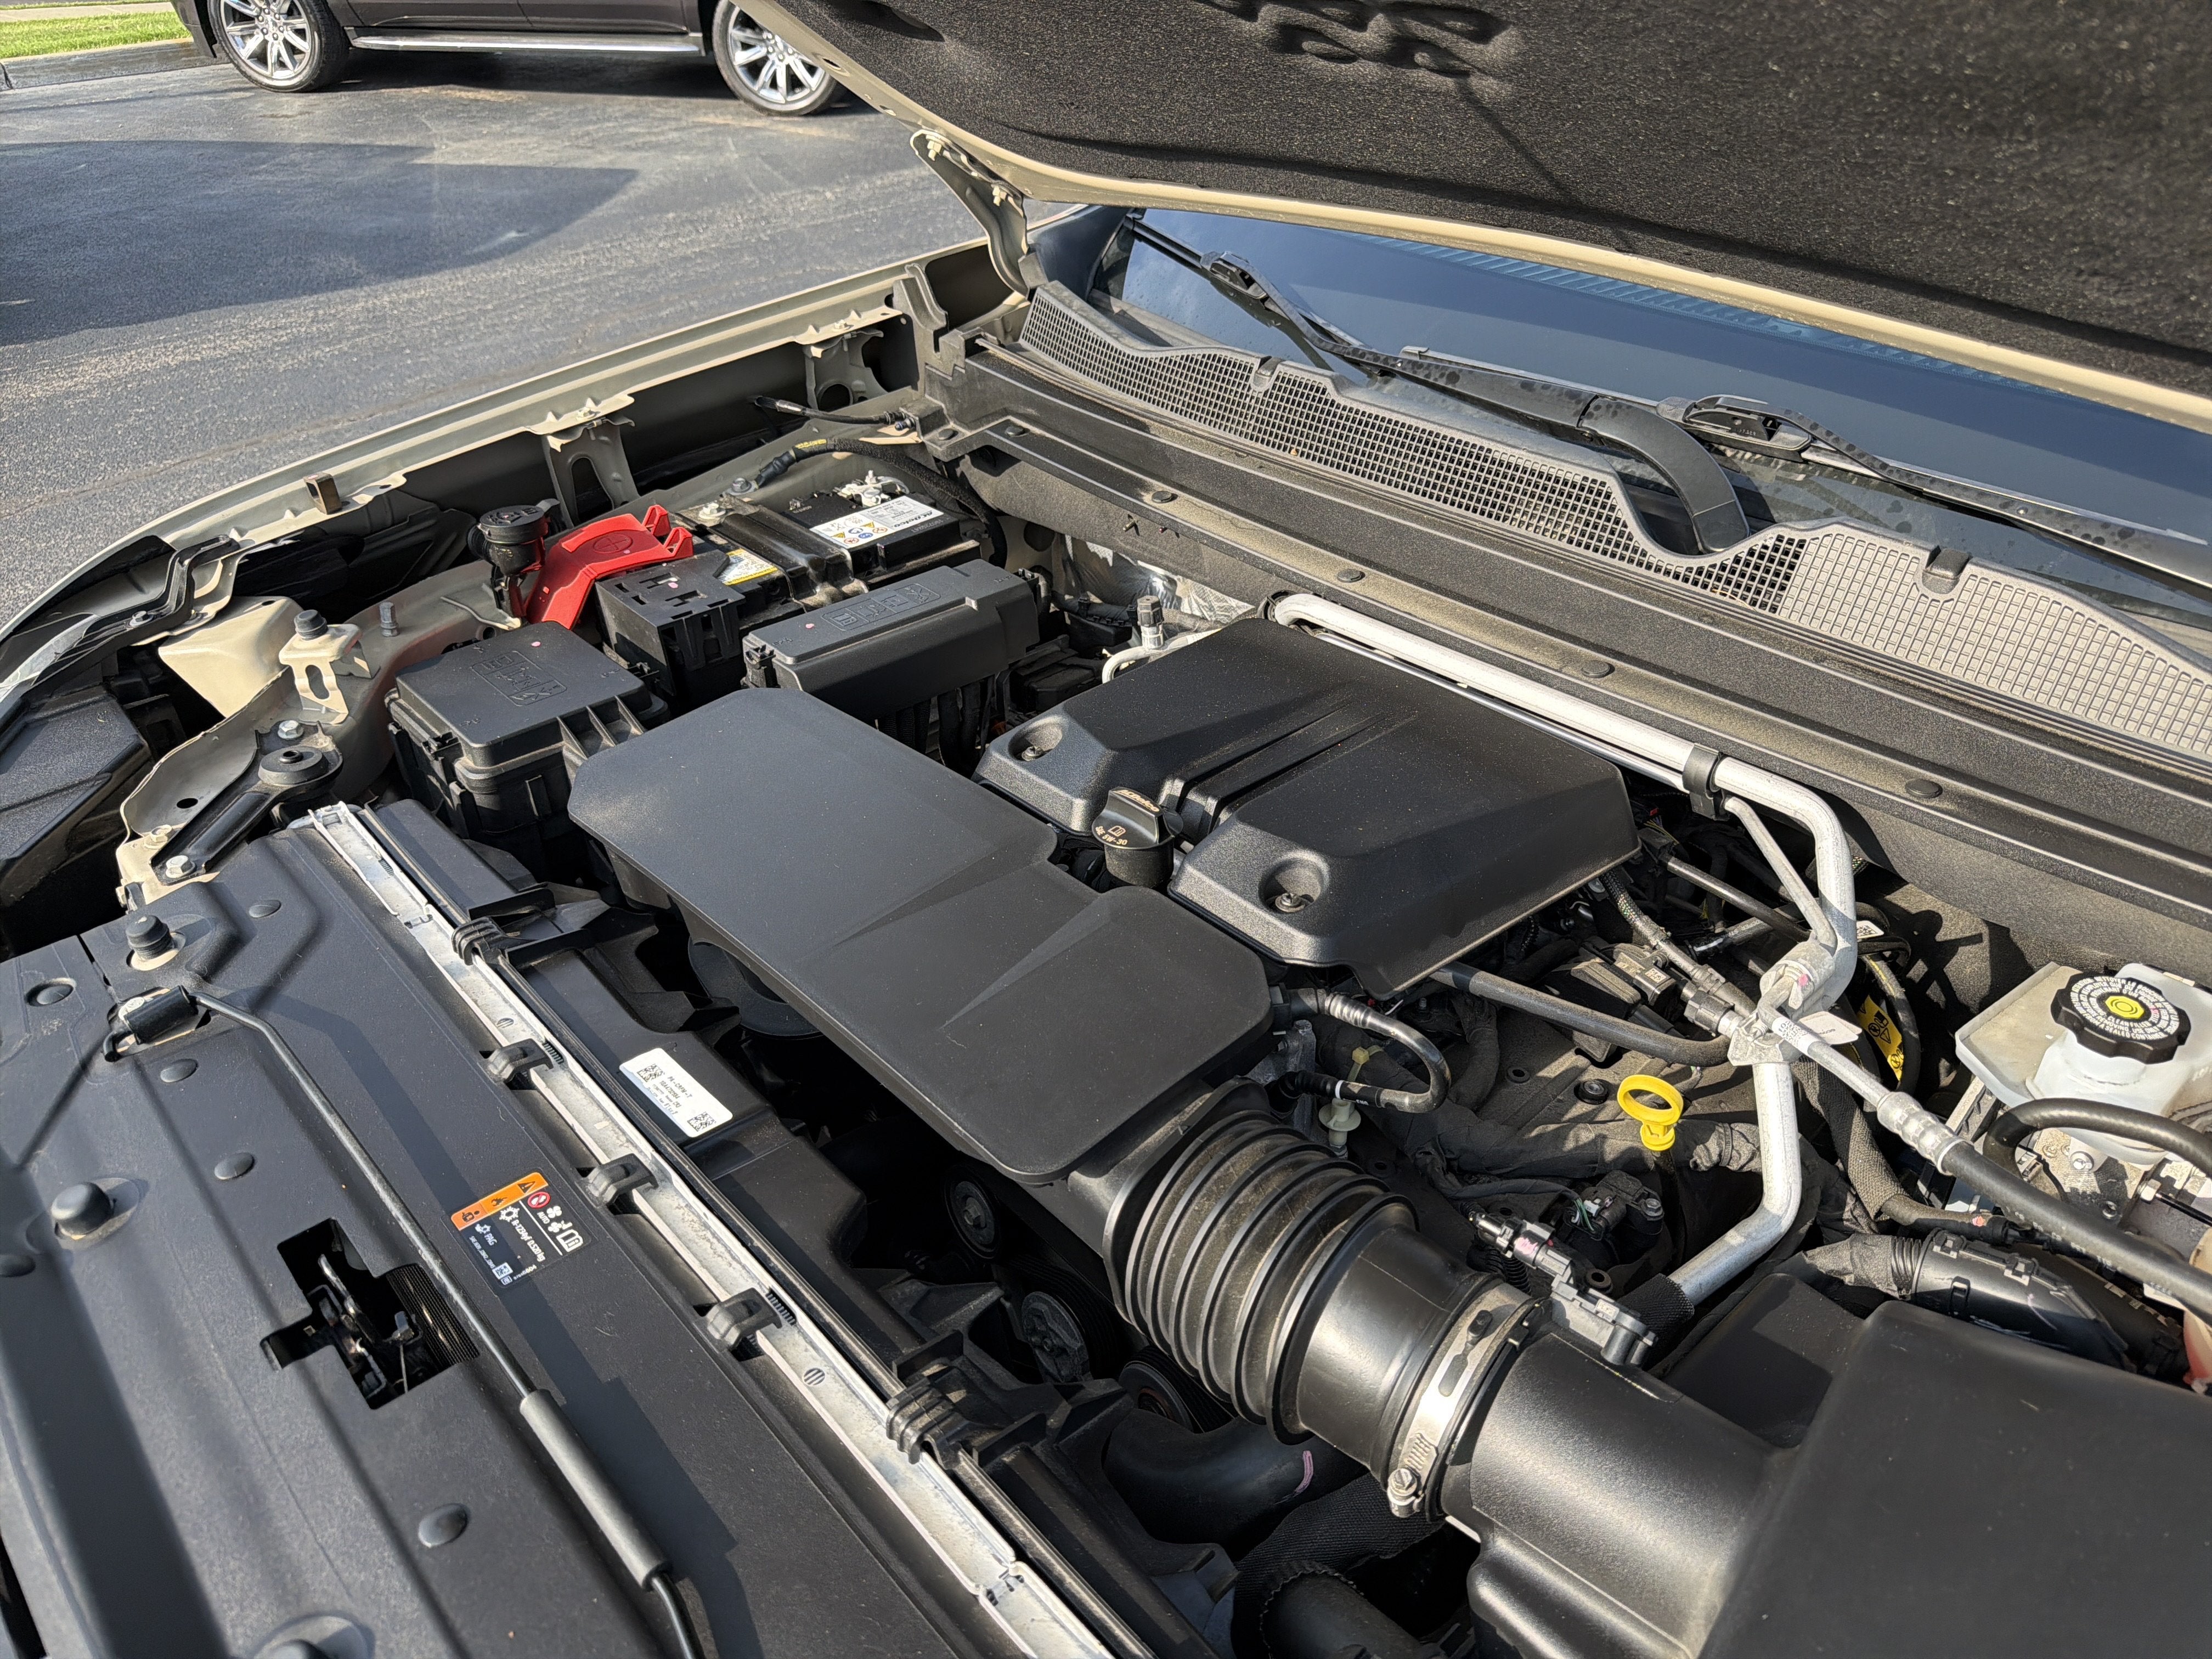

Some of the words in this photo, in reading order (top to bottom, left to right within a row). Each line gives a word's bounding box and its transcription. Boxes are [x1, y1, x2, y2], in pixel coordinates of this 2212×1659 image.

[894, 511, 933, 527] ACDelco
[1113, 789, 1160, 812] ACDelco
[1095, 826, 1105, 836] SAE
[1102, 834, 1128, 845] 5W-30
[2136, 984, 2165, 1001] BOUCHON
[2080, 1001, 2099, 1017] BEFORE
[2082, 1013, 2101, 1026] FROM
[2104, 1025, 2130, 1038] SEALED
[2130, 1031, 2168, 1040] CONTAINER
[2107, 1015, 2129, 1027] CLEAN
[537, 1211, 550, 1224] AUTO
[484, 1233, 498, 1246] PAG
[511, 1219, 533, 1241] R-1234yf
[527, 1240, 543, 1255] 0.520
[537, 1252, 546, 1262] kg
